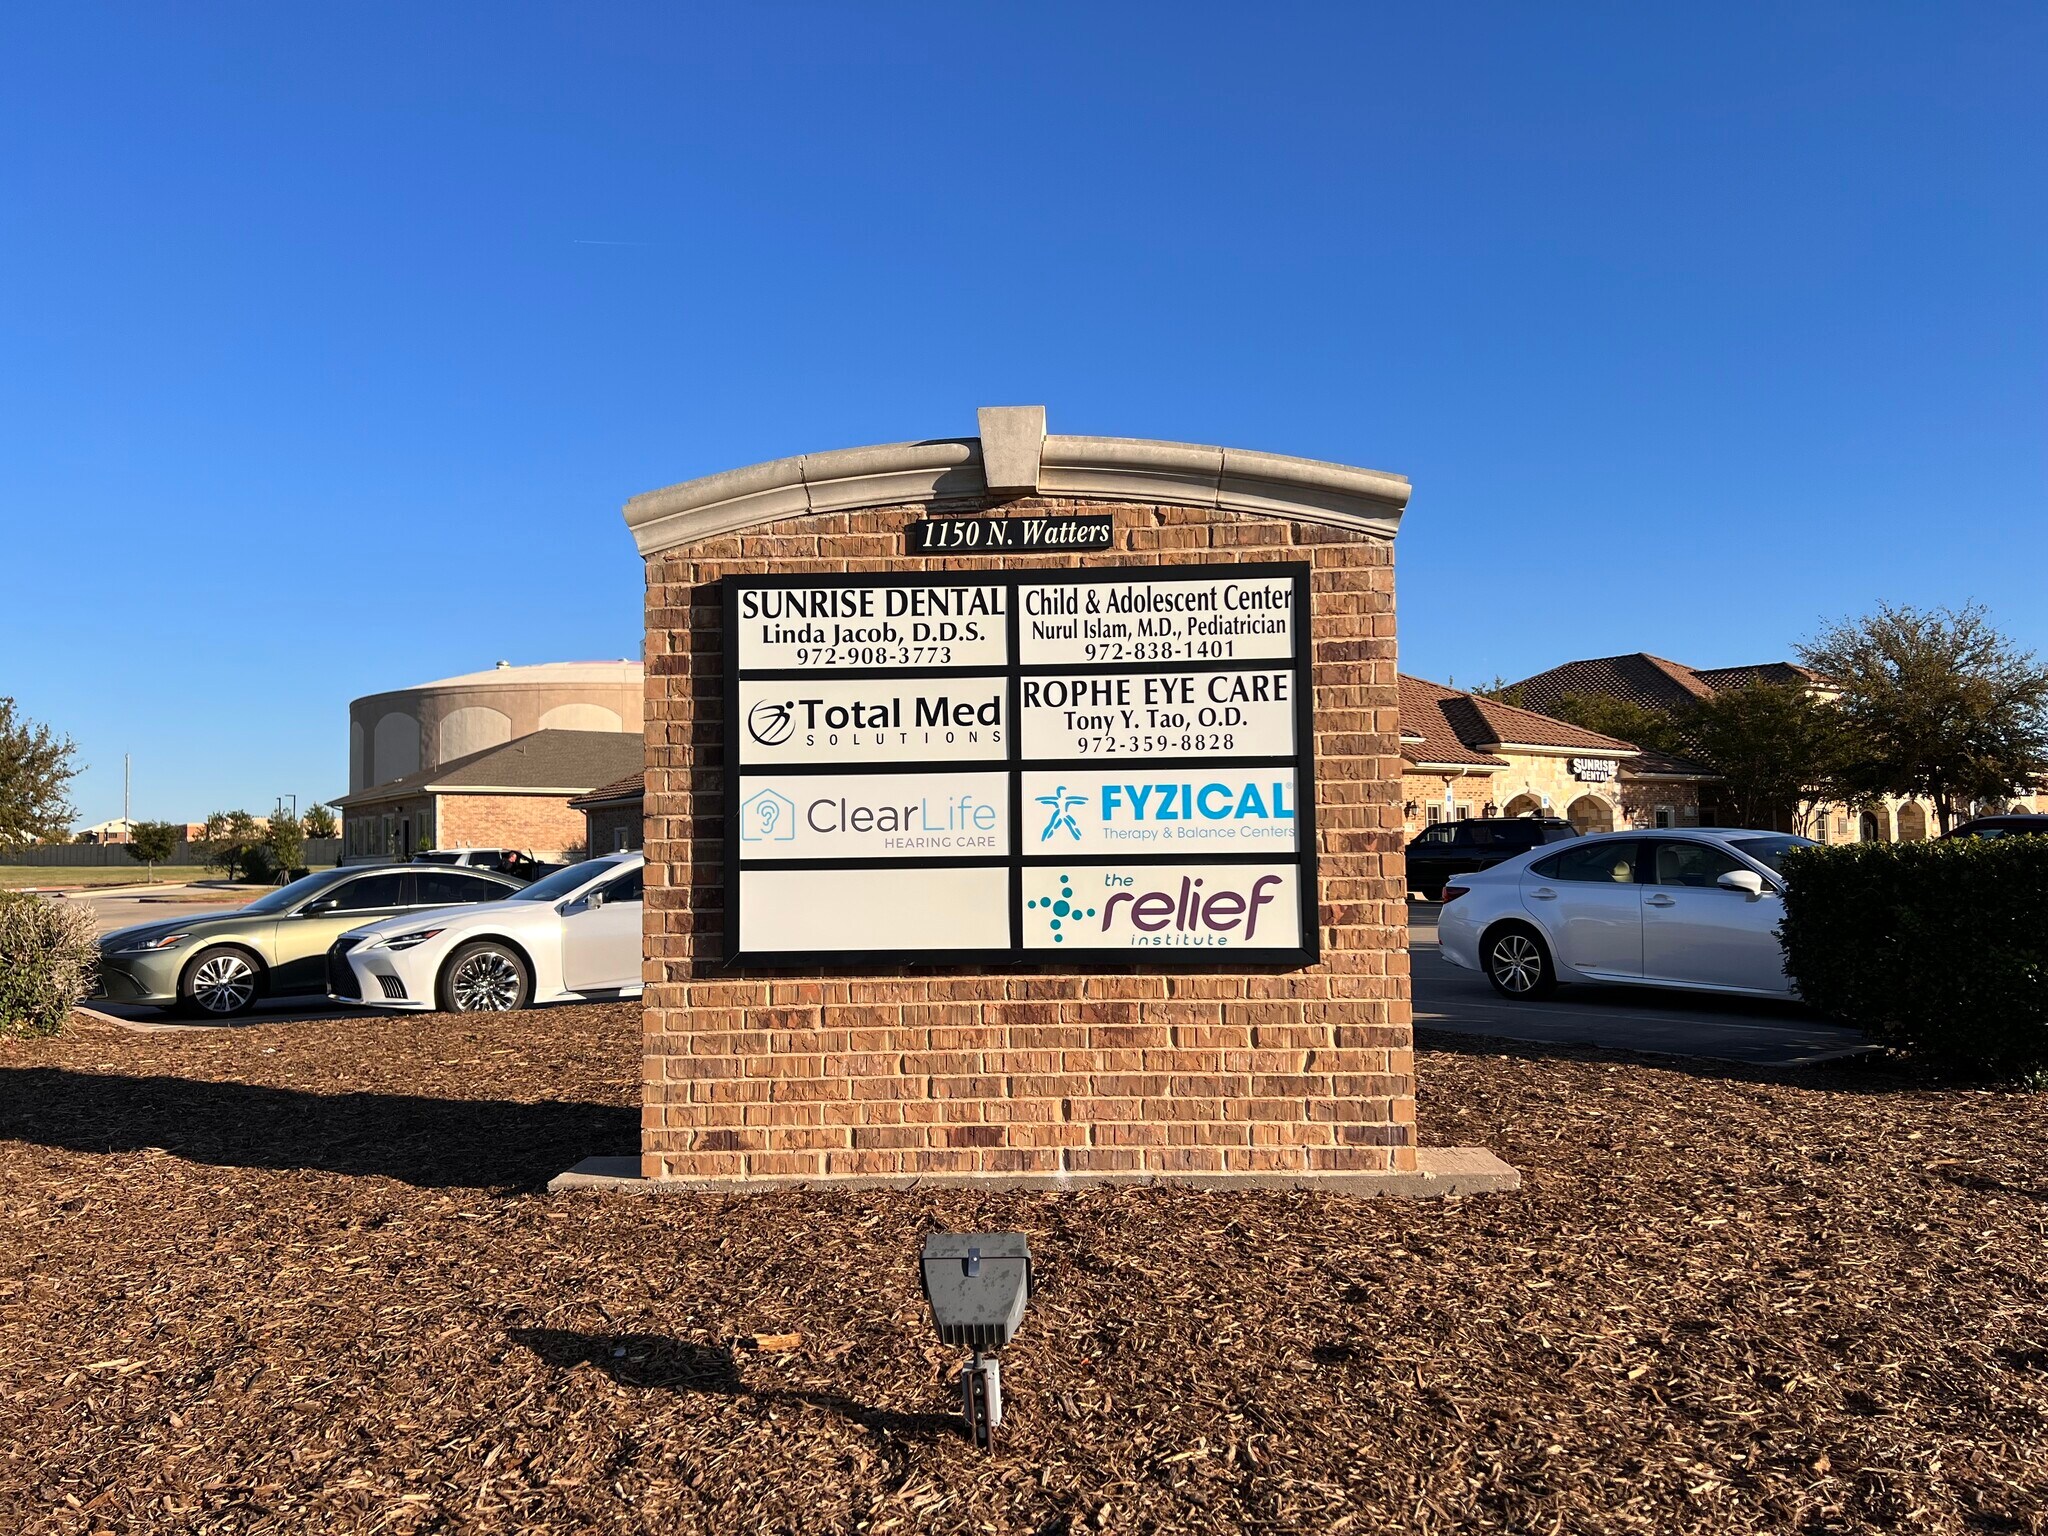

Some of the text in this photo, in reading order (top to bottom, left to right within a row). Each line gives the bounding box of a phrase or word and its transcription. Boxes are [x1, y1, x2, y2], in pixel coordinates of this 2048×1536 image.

[922, 518, 1110, 548] 1150 N. Watters
[742, 587, 1005, 619] SUNRISE DENTAL
[1025, 584, 1292, 616] Child & Adolescent Center
[762, 621, 986, 647] Linda Jacob, D.D.S.
[1032, 613, 1286, 642] Nurul Islam, M.D., Pediatrician
[796, 646, 952, 666] 972-908-3773
[1084, 640, 1235, 662] 972-838-1401
[1023, 674, 1288, 708] ROPHE EYE CARE
[799, 695, 1001, 730] Total Med
[1063, 706, 1249, 737] Tony Y. Tao, O.D.
[806, 730, 1001, 747] SOLUTIONS
[1077, 733, 1235, 754] 972-359-8828
[1573, 758, 1617, 775] SUNRISE
[1581, 771, 1611, 782] DENTAL
[807, 795, 996, 833] ClearLife
[1101, 782, 1295, 821] FYZICAL
[884, 836, 996, 849] HEARING CARE
[1102, 825, 1295, 841] Therapy & Balance Centers
[1104, 873, 1134, 887] the
[1101, 874, 1283, 941] relief
[1131, 934, 1228, 946] institute
